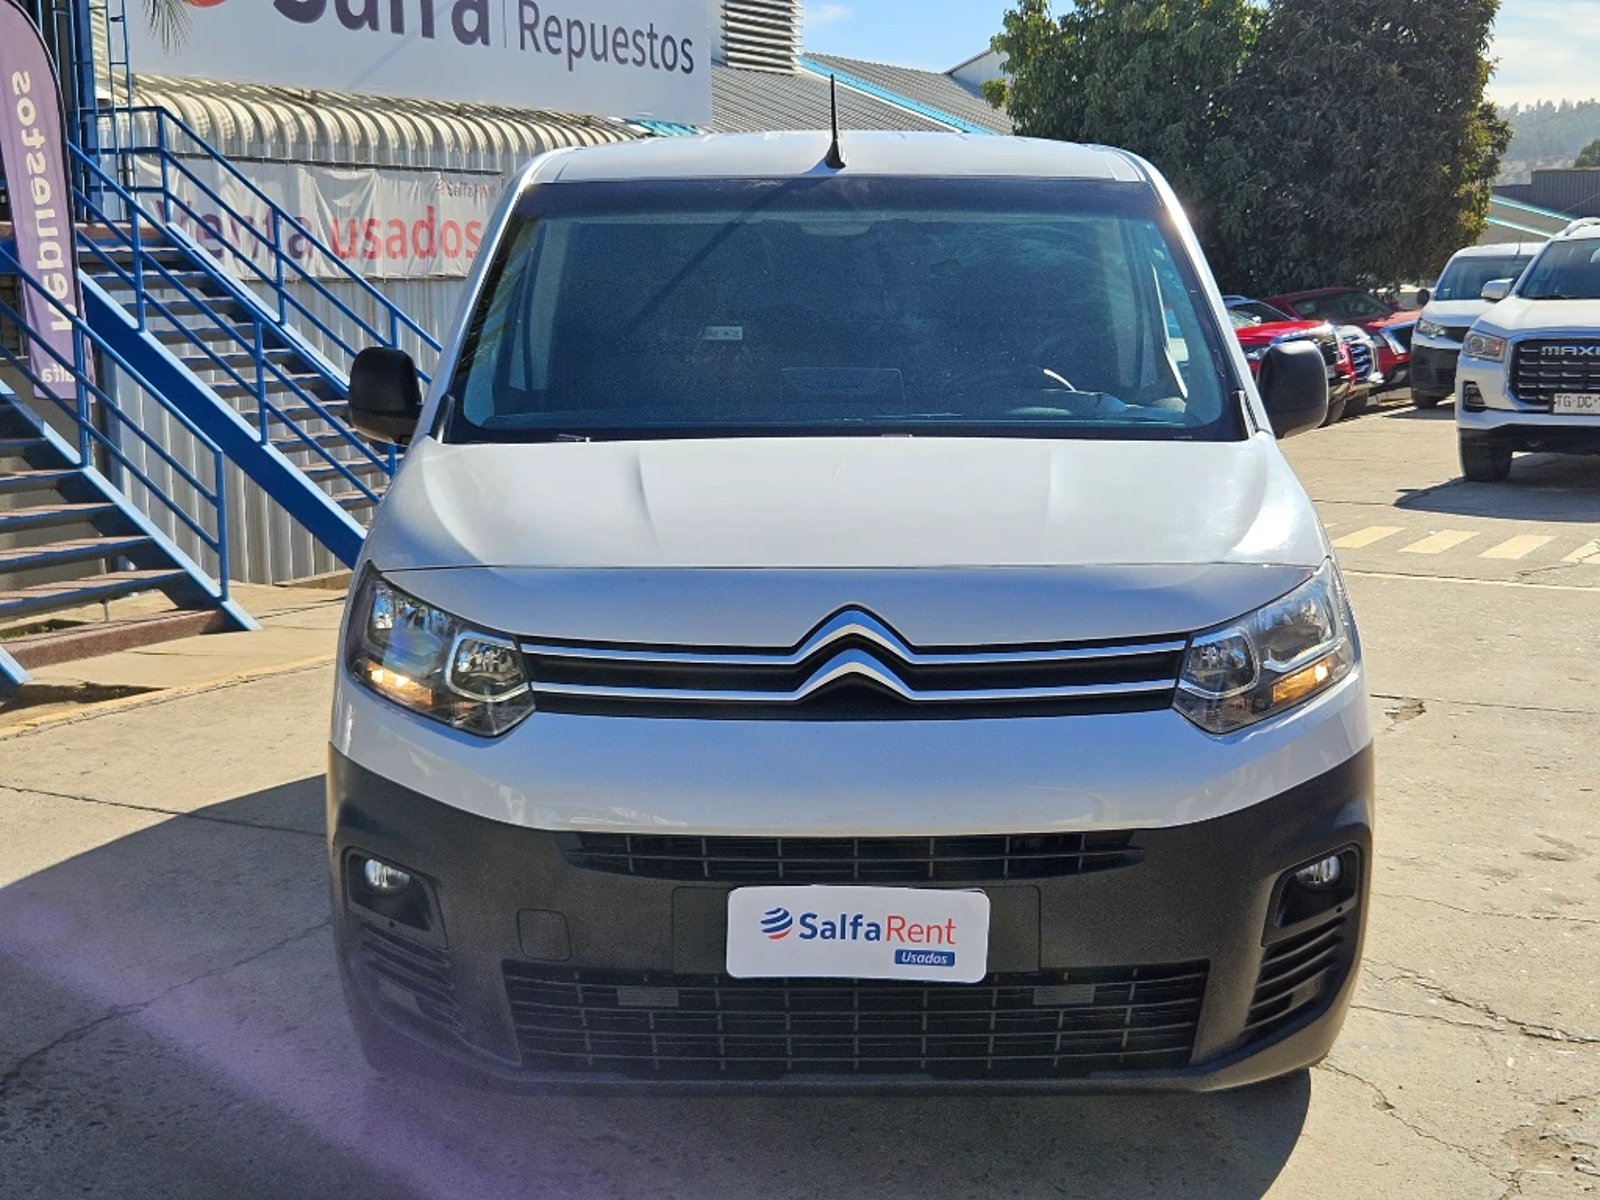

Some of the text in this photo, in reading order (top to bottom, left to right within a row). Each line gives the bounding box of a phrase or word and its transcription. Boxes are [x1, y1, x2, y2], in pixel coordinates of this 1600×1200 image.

[519, 1, 695, 75] Repuestos
[331, 205, 482, 259] usados
[1541, 346, 1600, 356] MAX
[798, 912, 957, 945] SalfaRent
[901, 951, 948, 965] Usados
